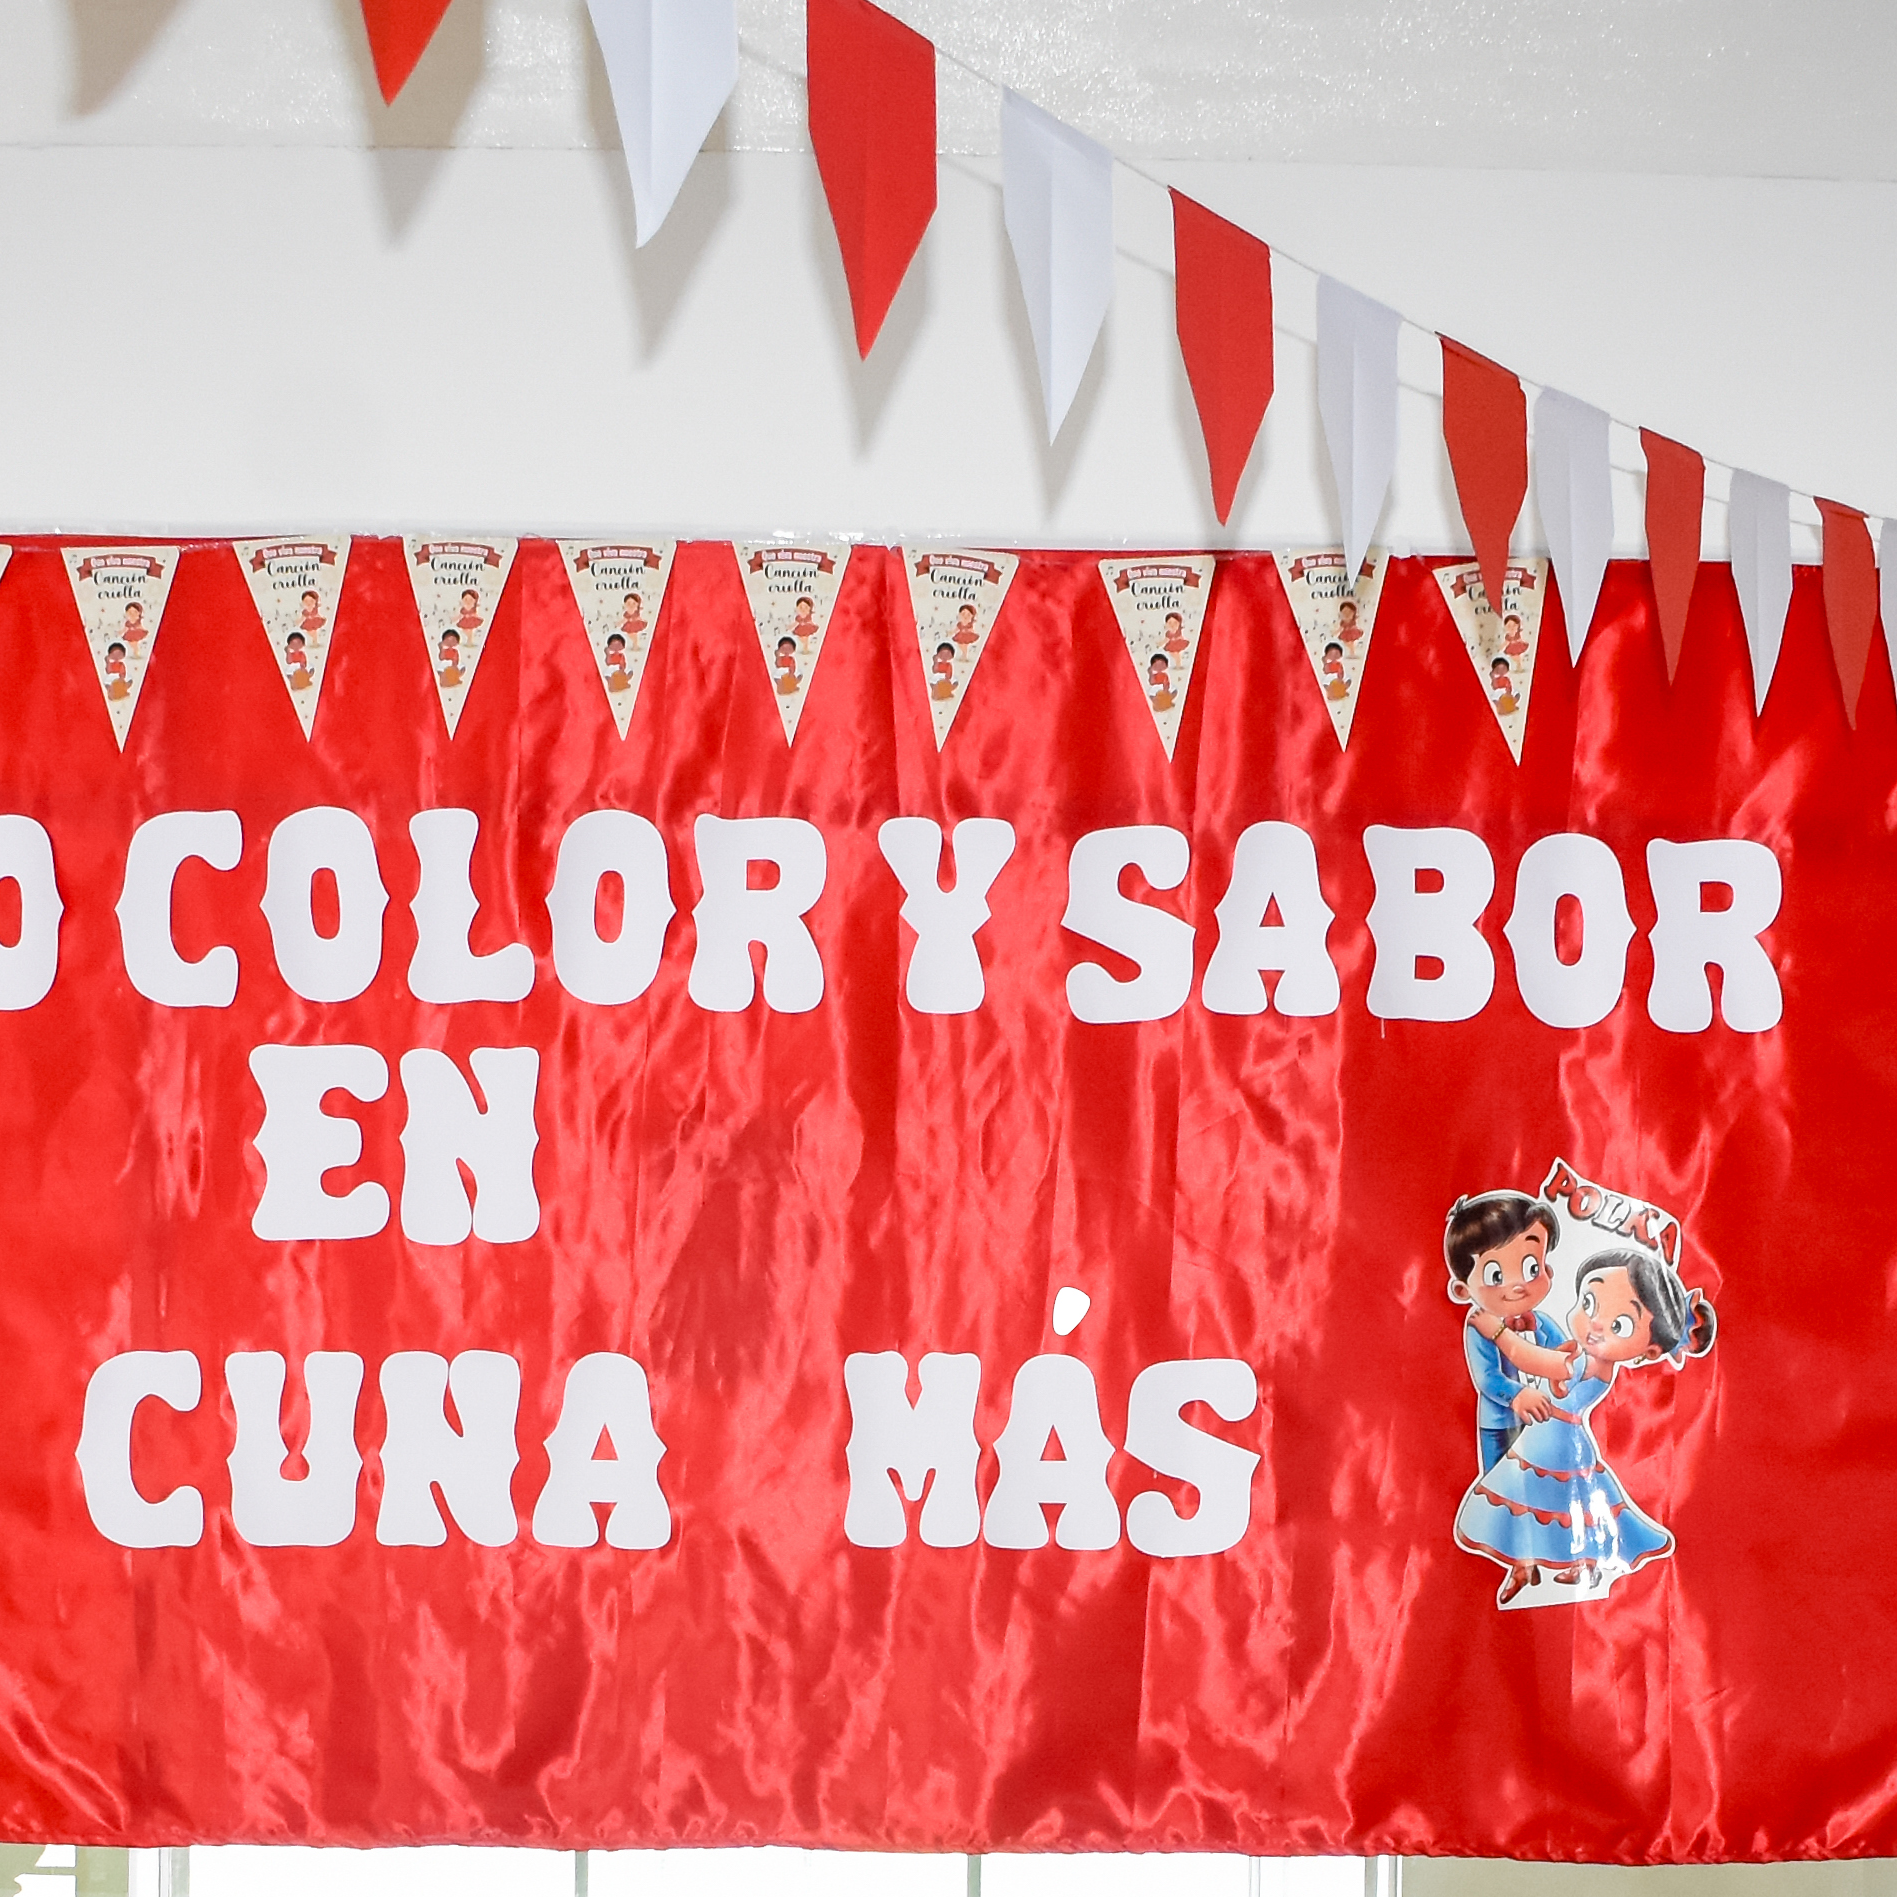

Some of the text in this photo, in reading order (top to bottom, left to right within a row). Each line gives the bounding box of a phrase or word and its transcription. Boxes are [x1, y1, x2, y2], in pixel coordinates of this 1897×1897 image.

[1307, 570, 1359, 585] Canció
[116, 806, 827, 1013] COLOR
[878, 816, 1016, 1014] Y
[1063, 820, 1783, 1033] SABOR
[249, 1043, 540, 1246] EN
[1543, 1162, 1678, 1267] POLKA
[76, 1286, 1258, 1558] CUNA MÁS
